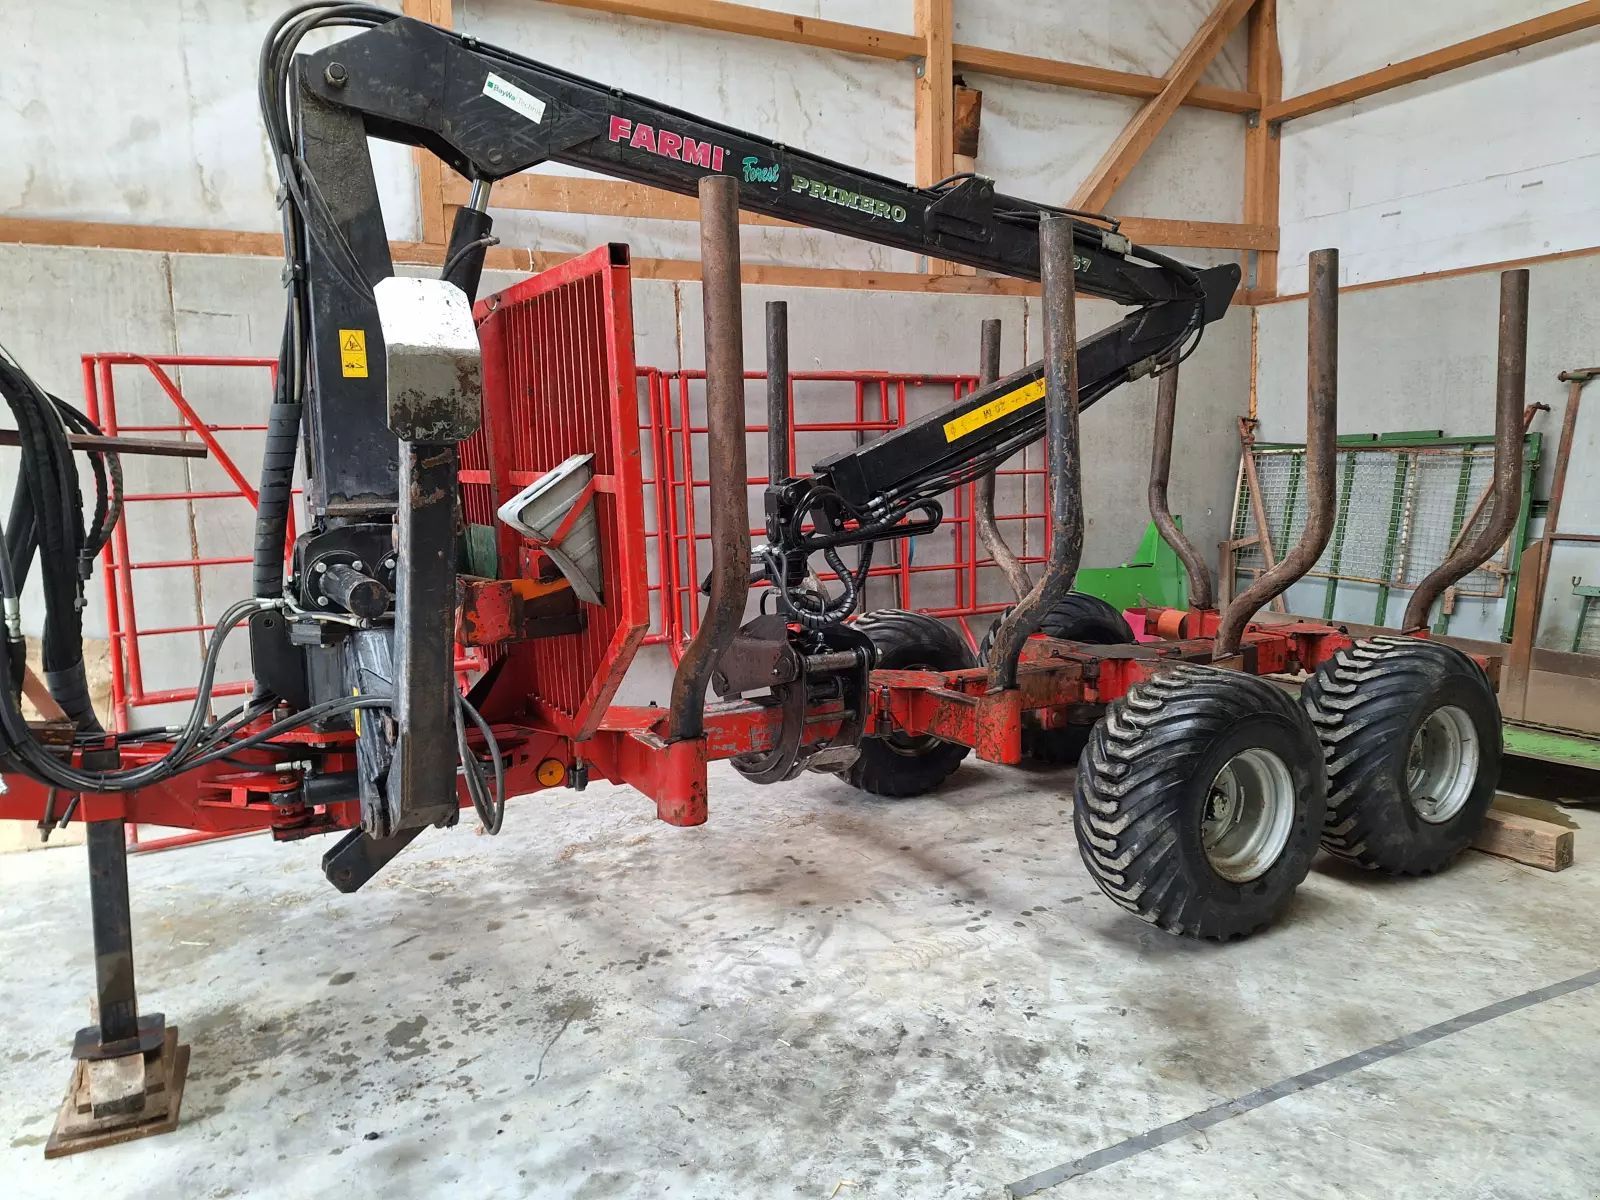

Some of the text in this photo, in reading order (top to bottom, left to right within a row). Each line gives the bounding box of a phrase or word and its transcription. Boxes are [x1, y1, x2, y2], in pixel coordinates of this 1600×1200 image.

[493, 84, 516, 101] BayWa
[609, 115, 907, 223] FARMI Forest PRIMERO
